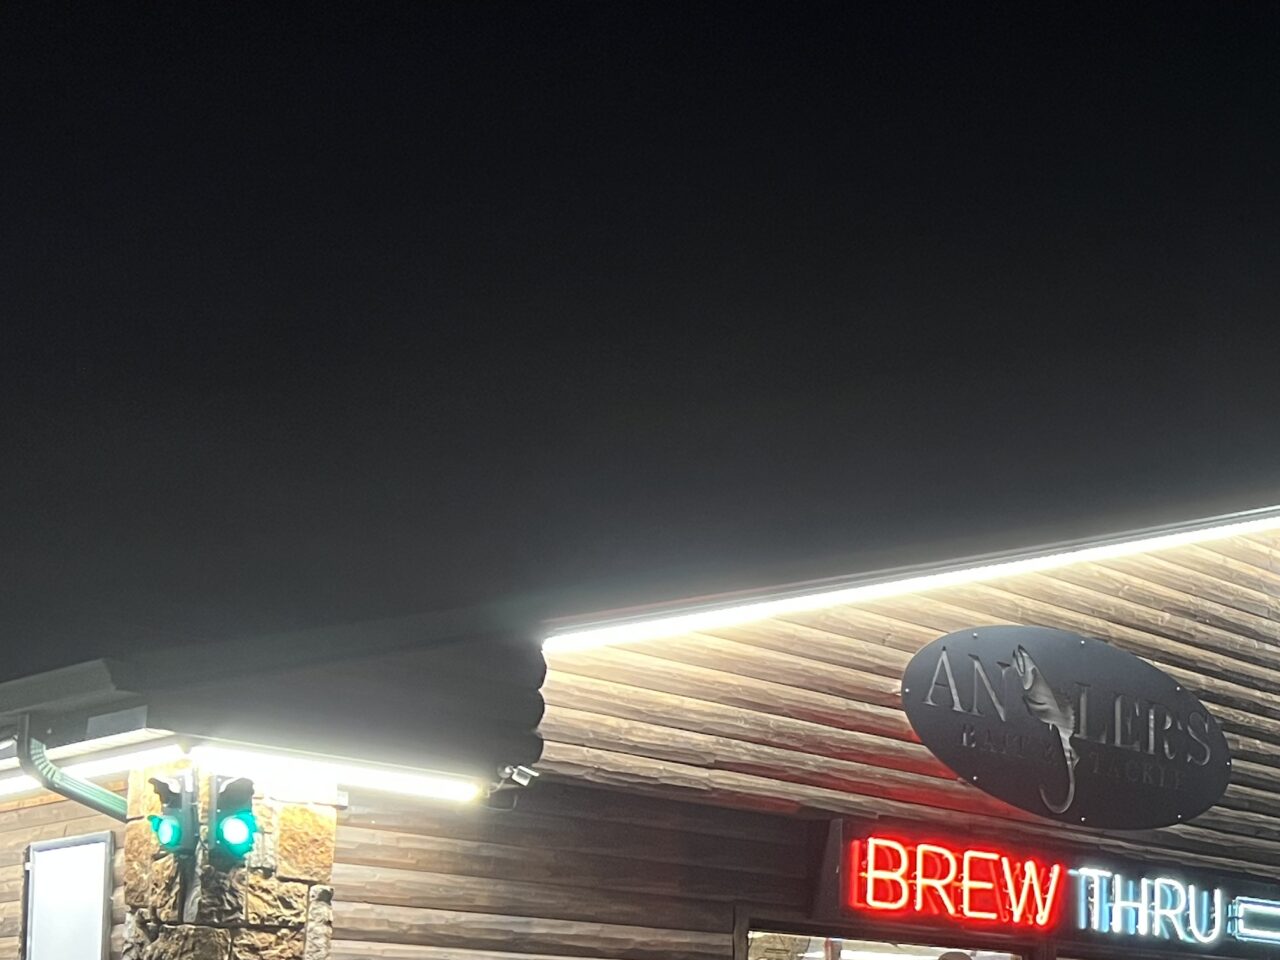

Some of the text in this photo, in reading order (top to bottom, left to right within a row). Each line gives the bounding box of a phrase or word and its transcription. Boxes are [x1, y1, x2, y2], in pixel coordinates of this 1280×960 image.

[923, 645, 1211, 767] ANLERS
[862, 836, 1222, 943] BREW THRU
